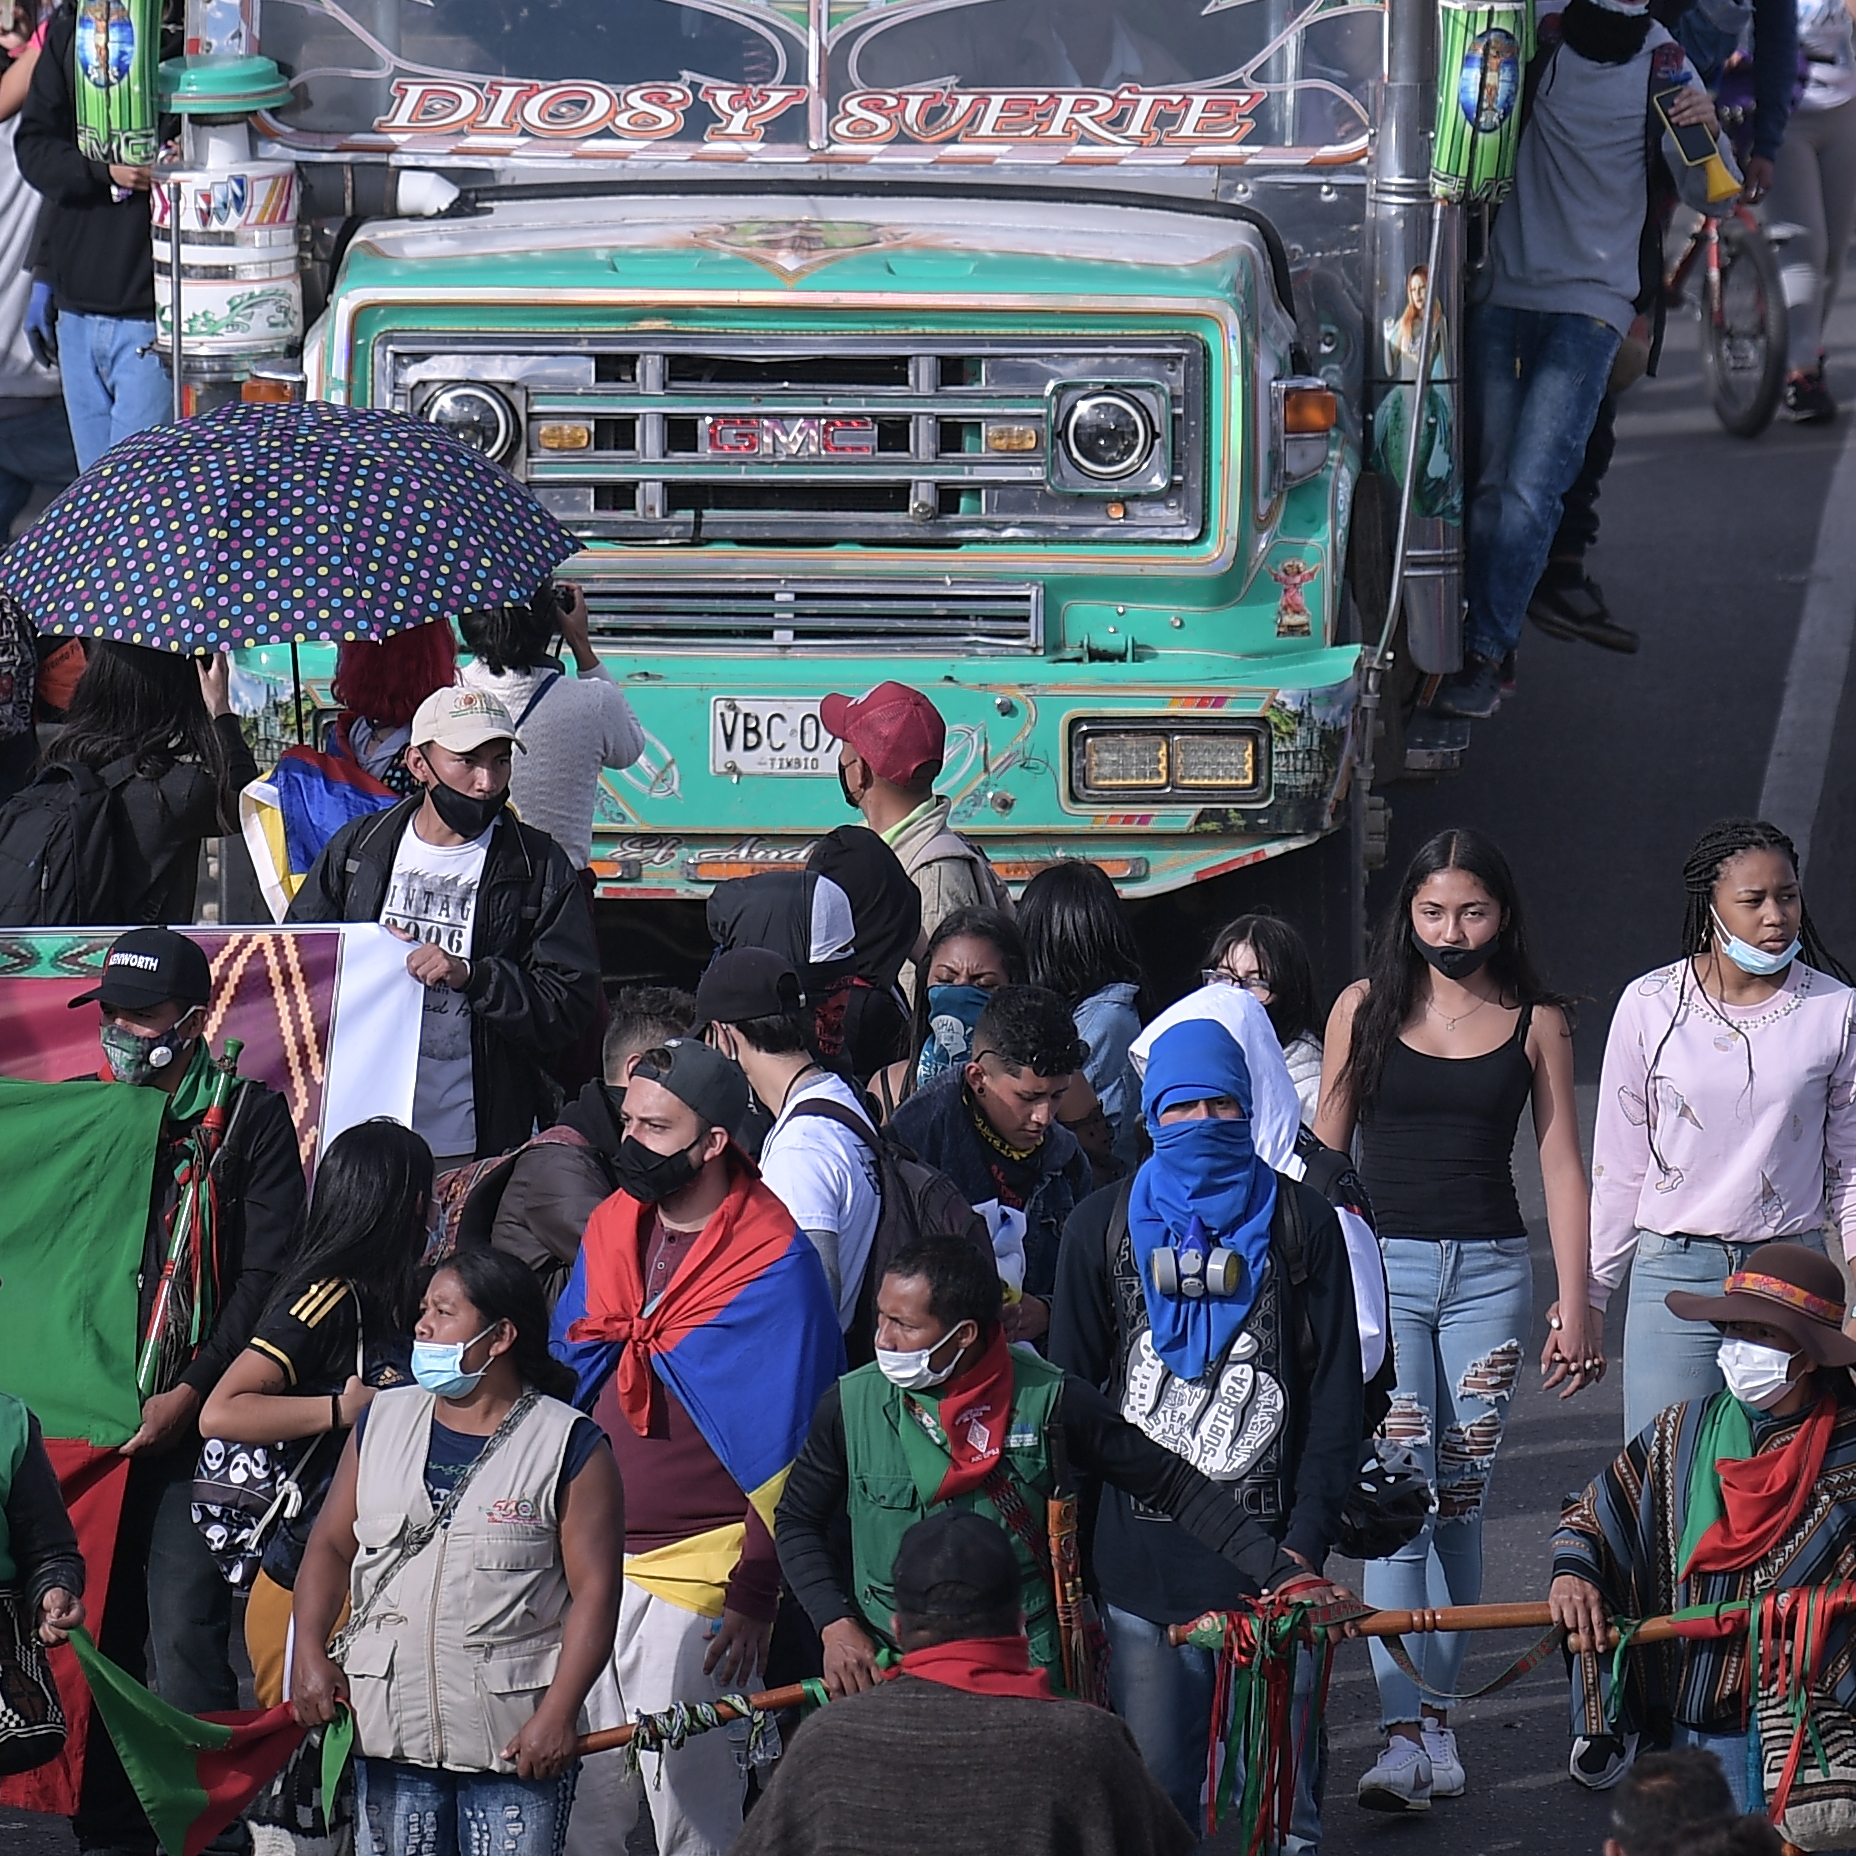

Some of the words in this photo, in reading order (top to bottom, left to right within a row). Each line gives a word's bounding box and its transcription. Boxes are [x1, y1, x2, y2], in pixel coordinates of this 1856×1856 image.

[372, 77, 693, 139] DIOS
[700, 84, 809, 144] Y
[829, 83, 1267, 146] SUERTE
[707, 417, 874, 455] GMC
[719, 711, 787, 754] VBC
[769, 757, 820, 771] TIMBIO
[690, 837, 820, 865] And
[388, 885, 472, 920] INTAG
